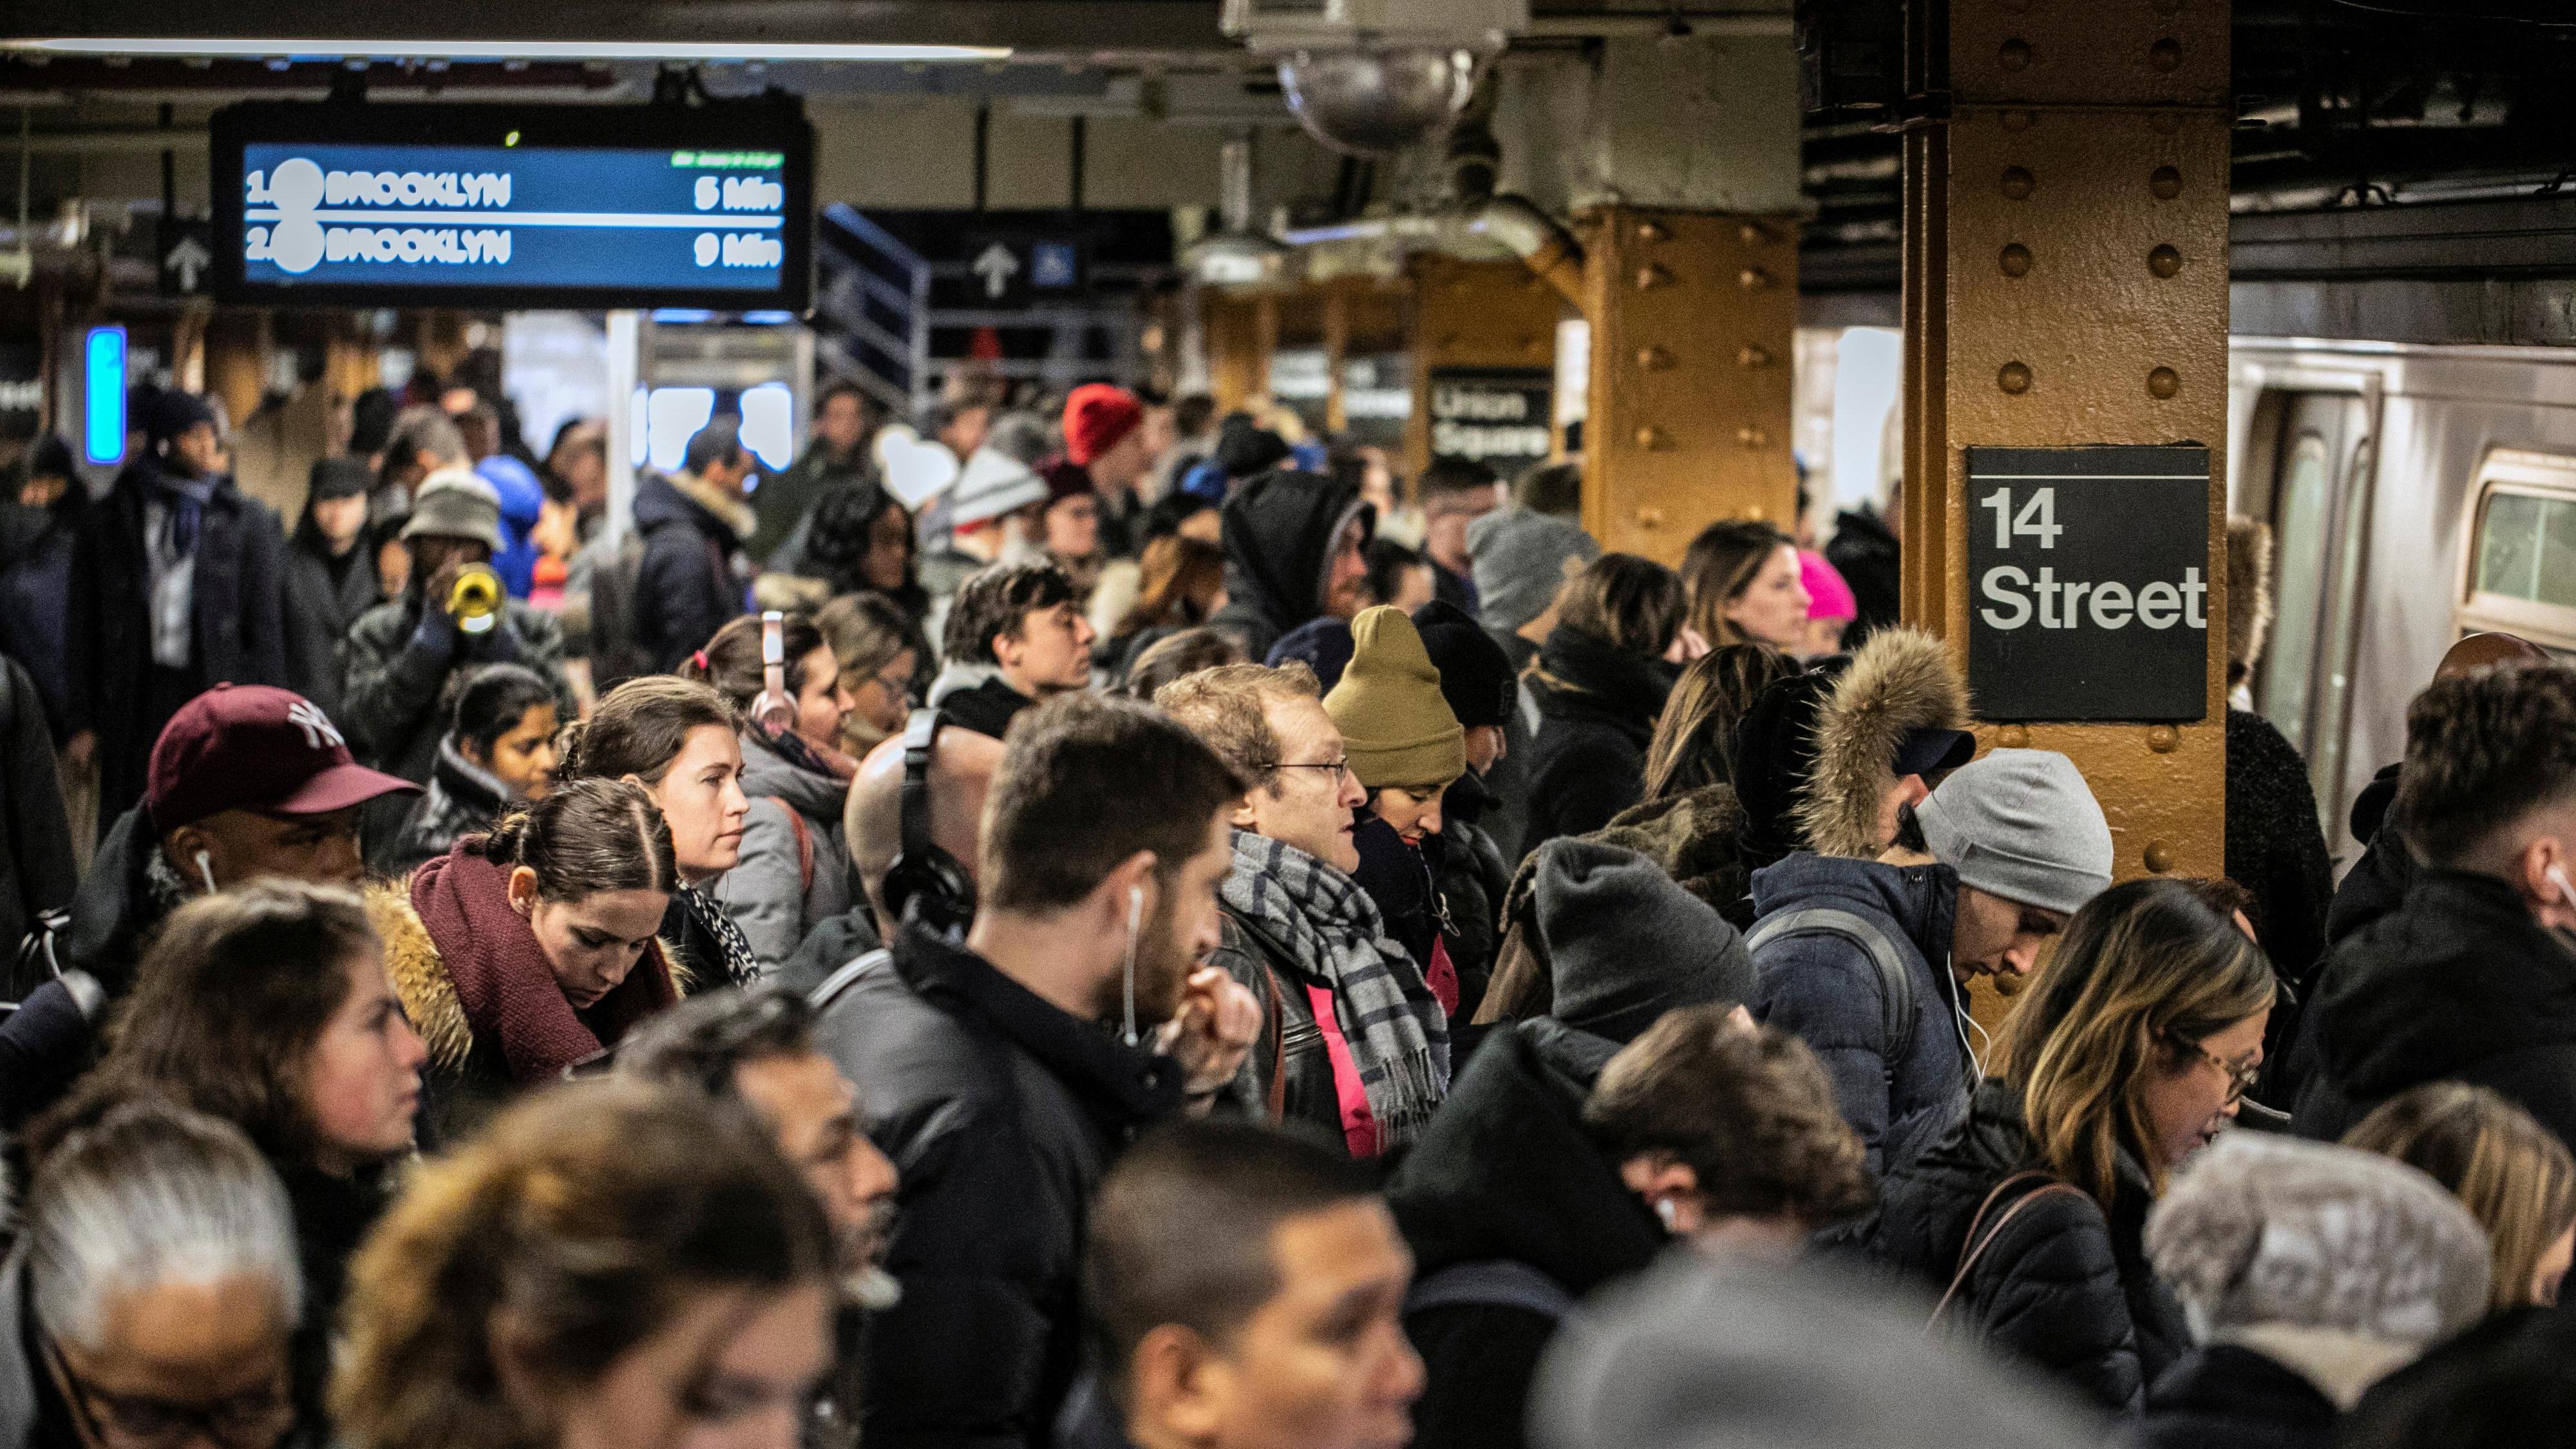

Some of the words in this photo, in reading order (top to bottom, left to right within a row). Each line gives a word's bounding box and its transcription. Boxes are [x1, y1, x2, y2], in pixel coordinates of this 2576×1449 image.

[325, 171, 511, 207] BROOKLYN
[325, 227, 511, 264] BROOKLYN
[1433, 386, 1528, 419] Union
[1981, 487, 2063, 549] 14
[1981, 565, 2207, 629] Street
